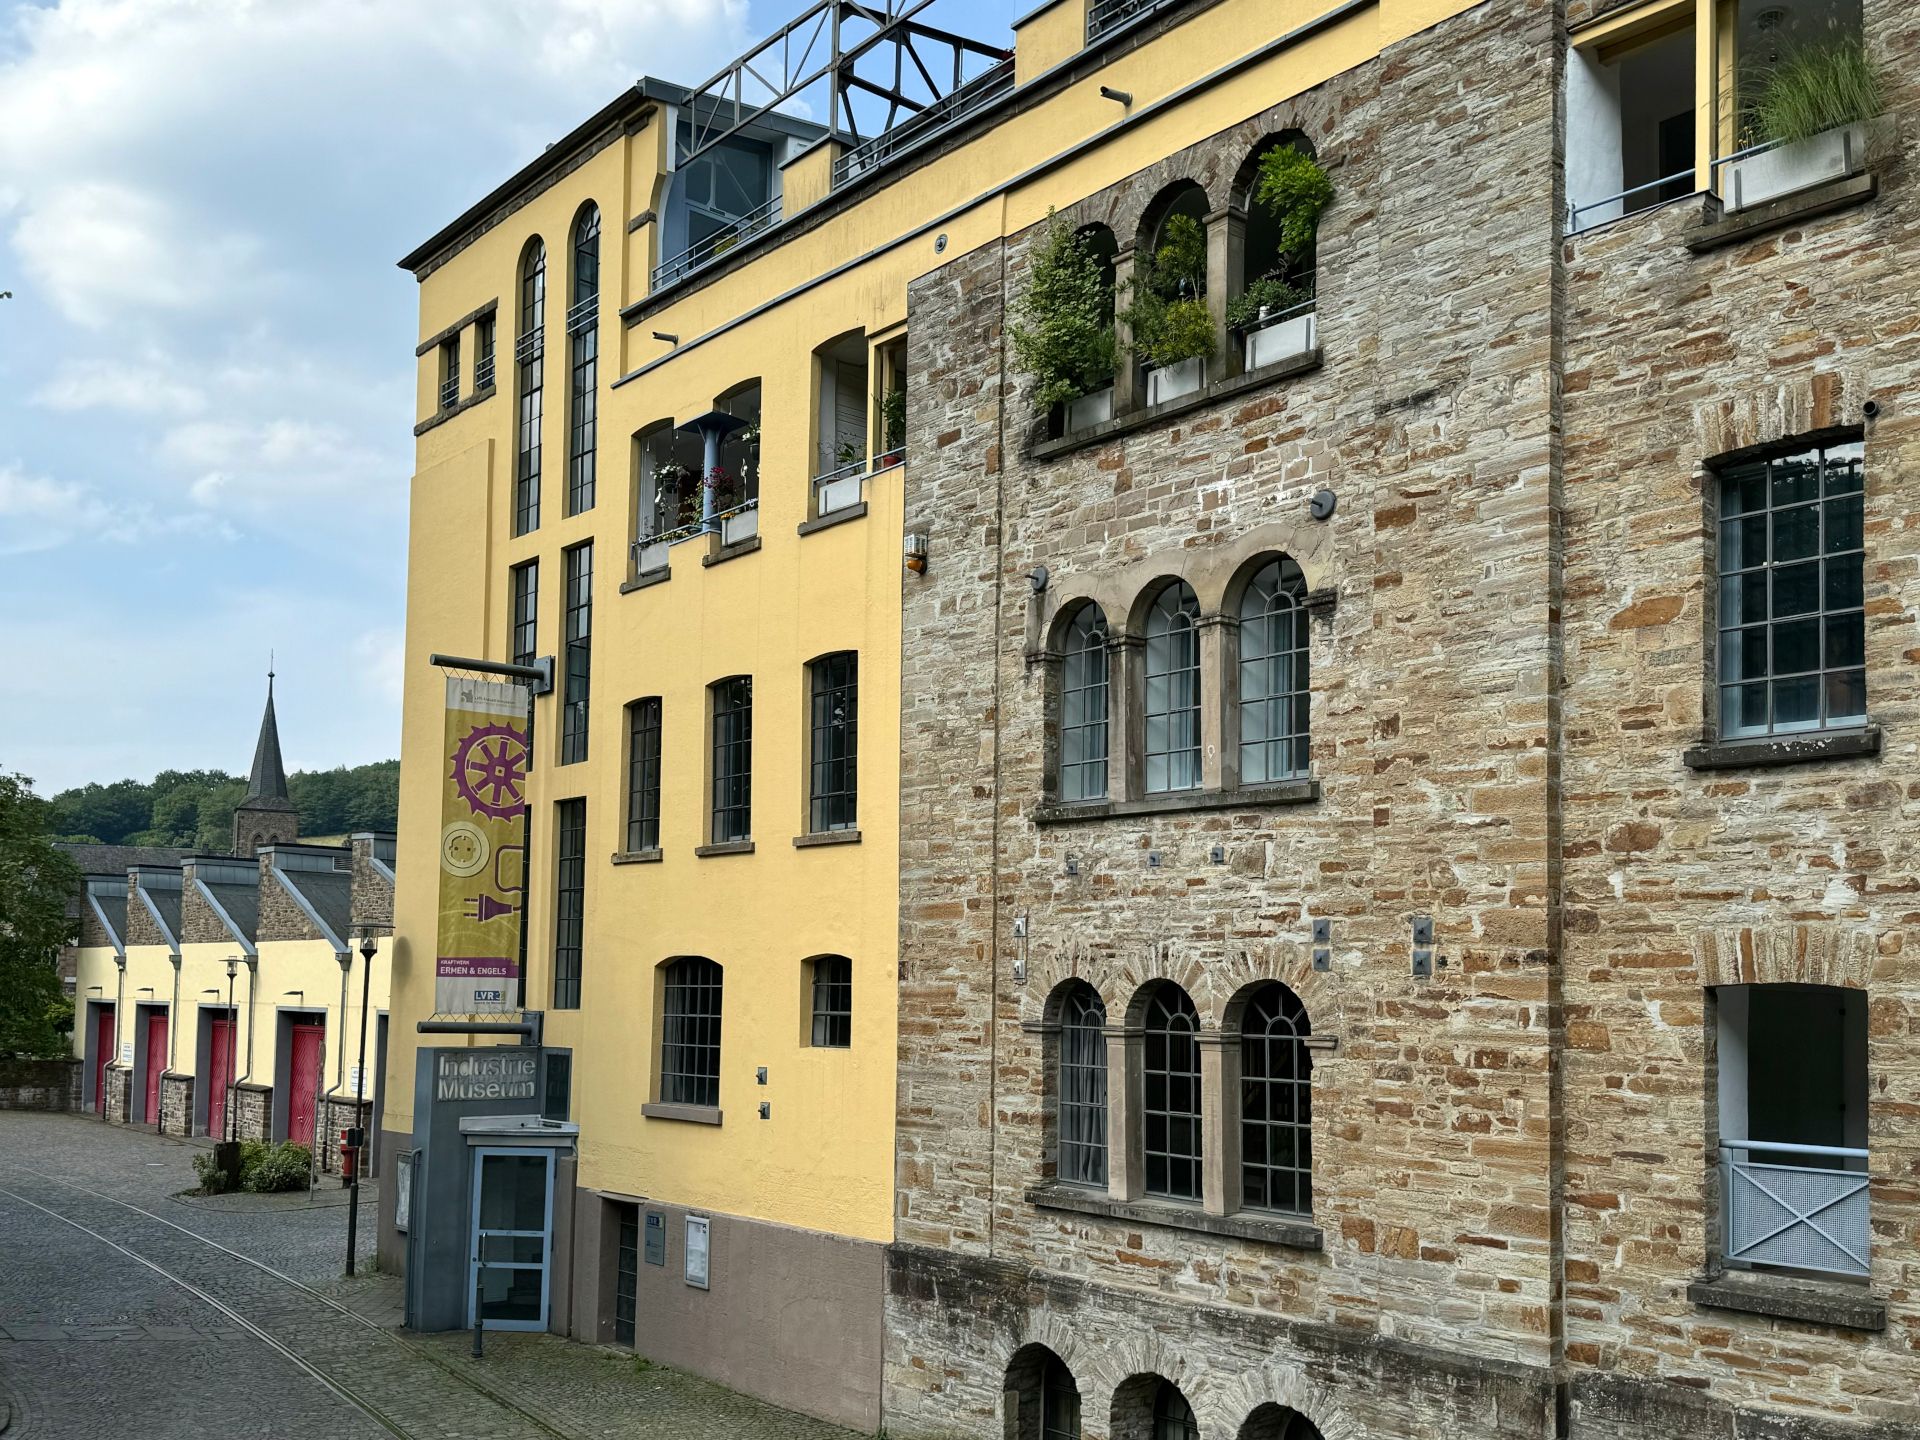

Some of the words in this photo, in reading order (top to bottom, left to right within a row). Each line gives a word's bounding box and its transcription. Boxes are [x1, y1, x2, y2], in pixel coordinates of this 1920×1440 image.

[440, 966, 468, 974] ERMEN
[477, 967, 507, 975] ENGELS
[475, 991, 494, 1000] LVR
[439, 1055, 536, 1076] Industrie
[438, 1078, 535, 1099] Museum
